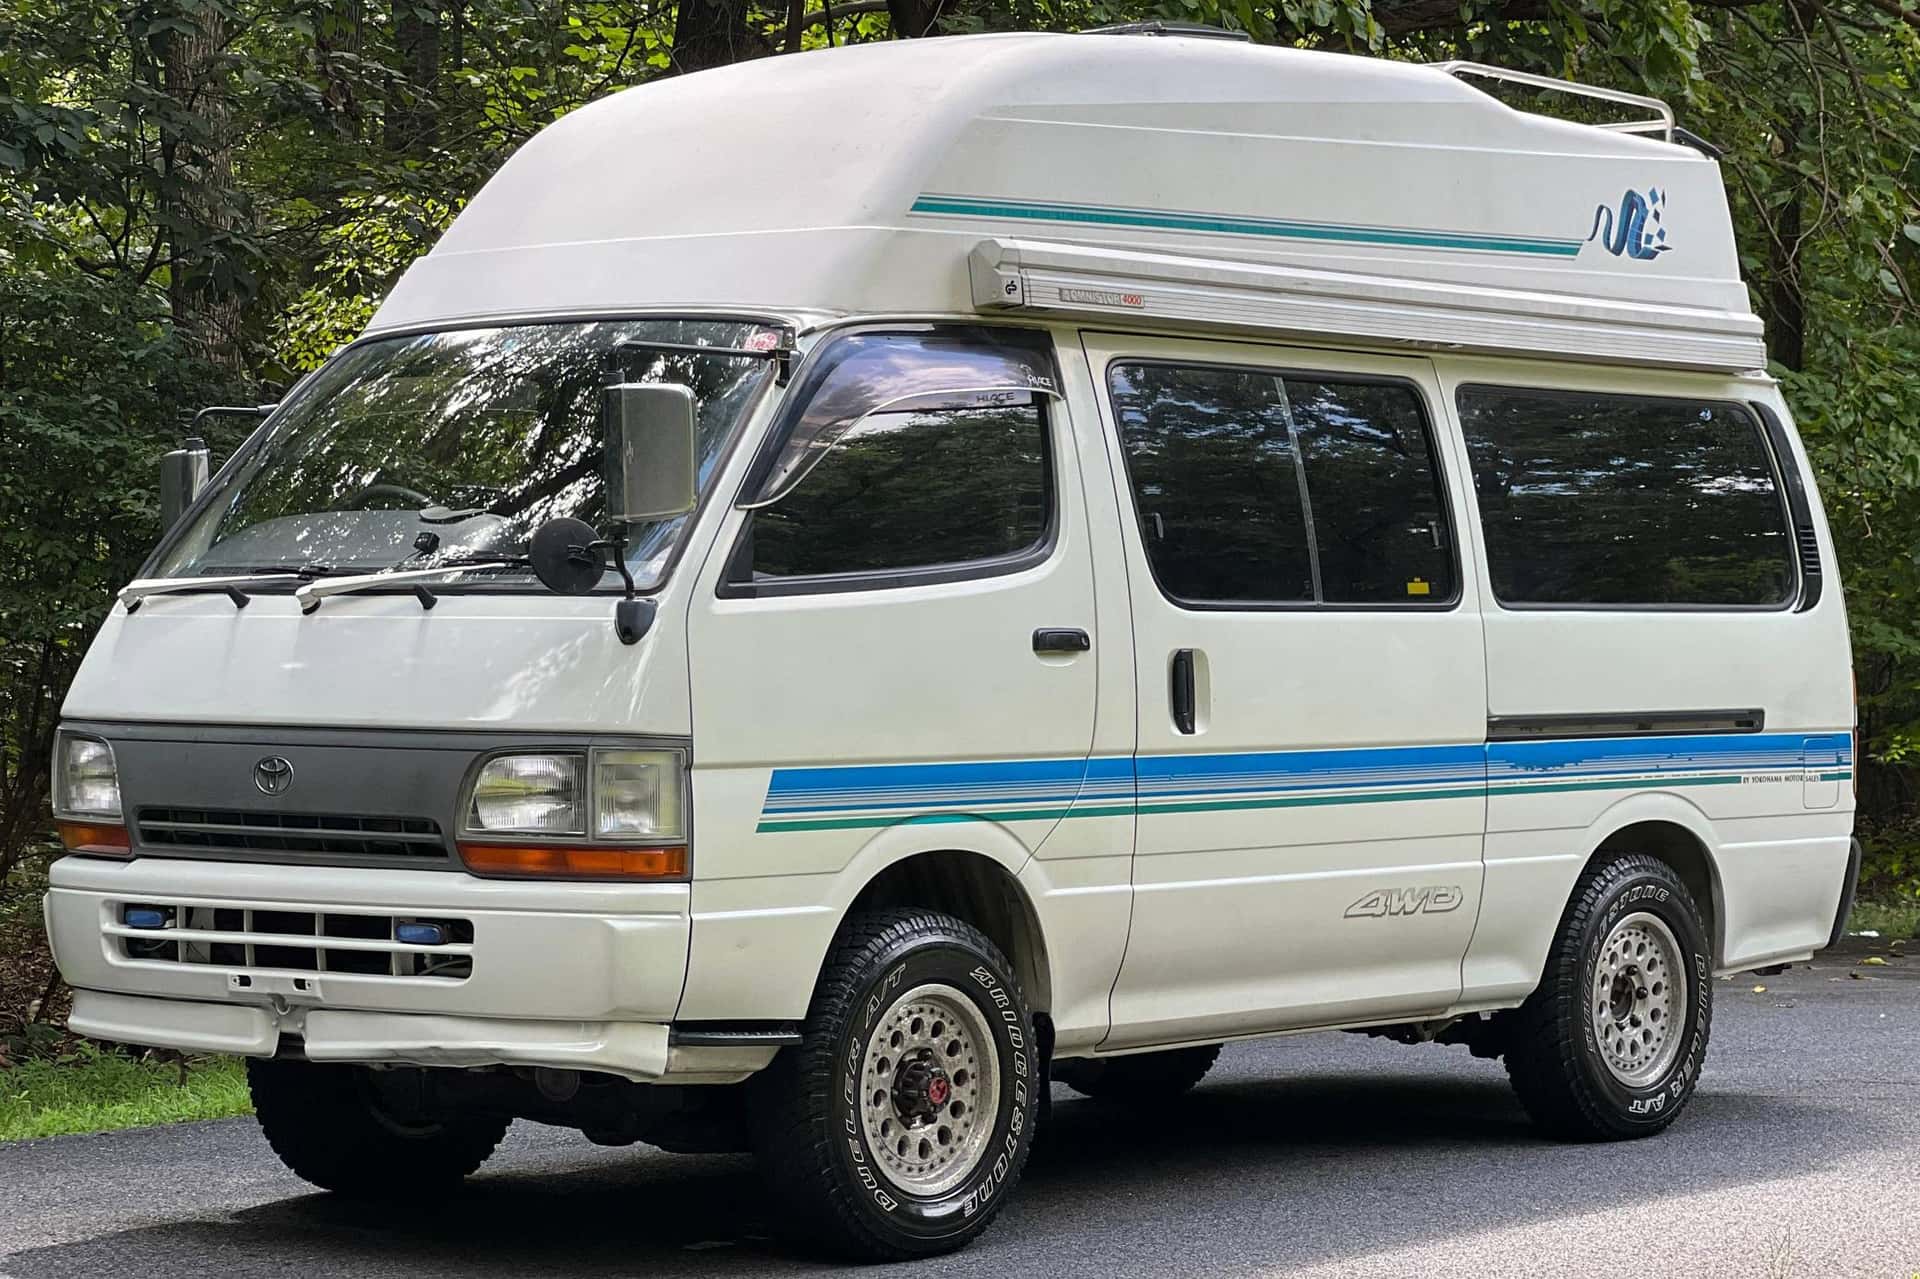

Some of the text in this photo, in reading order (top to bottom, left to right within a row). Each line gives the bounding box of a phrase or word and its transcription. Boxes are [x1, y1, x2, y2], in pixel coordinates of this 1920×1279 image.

[1121, 294, 1142, 306] 4000
[976, 391, 1015, 403] HIACE
[1752, 775, 1783, 784] YOKOHAMA
[1785, 774, 1804, 782] MOTOR
[1343, 885, 1464, 919] 4WD
[1628, 953, 1708, 1114] DUELER A/T
[844, 962, 907, 1213] DUELER A/T
[963, 966, 1028, 1217] BRIDGESTONE
